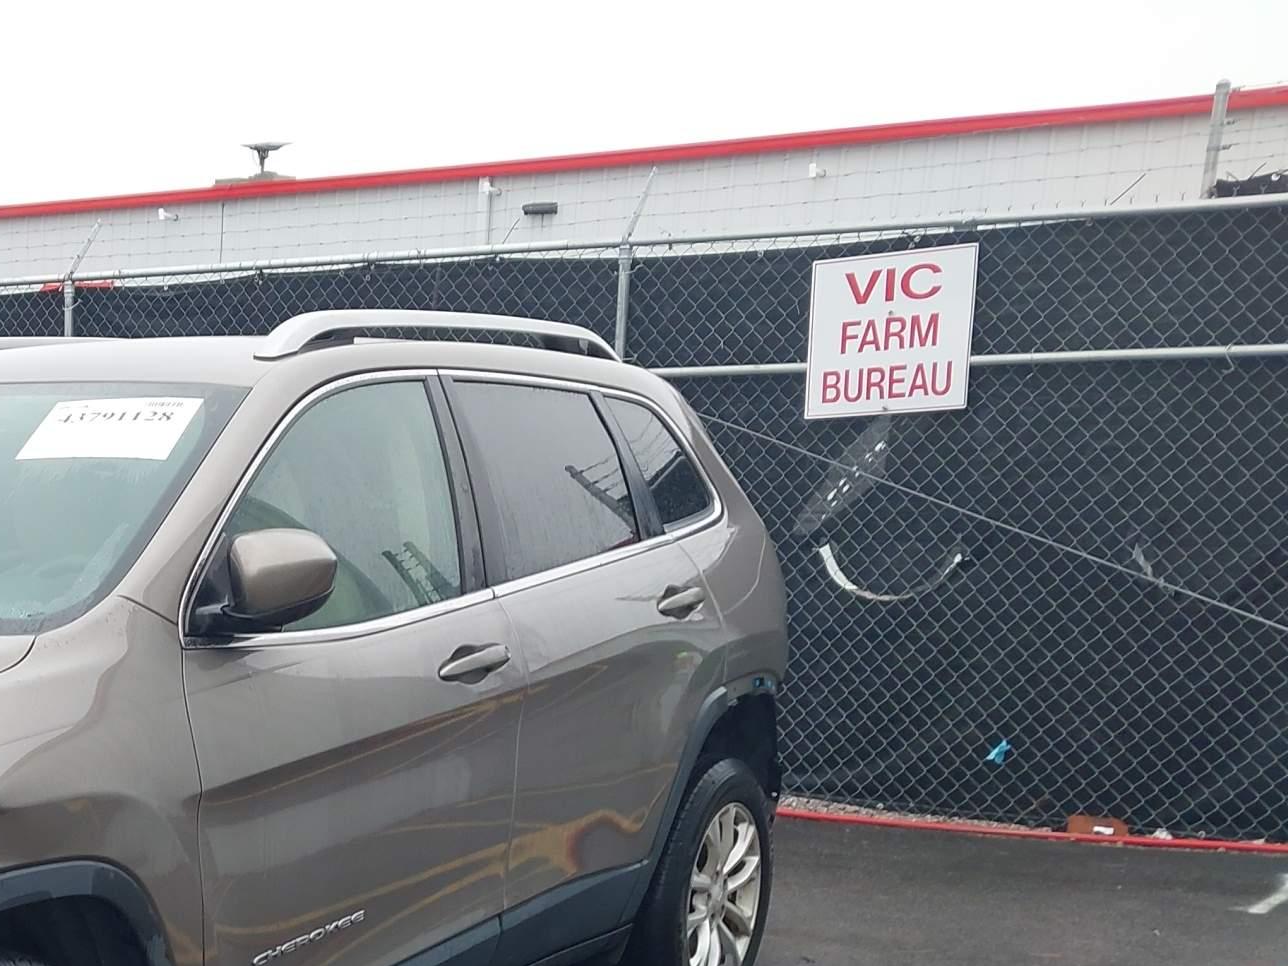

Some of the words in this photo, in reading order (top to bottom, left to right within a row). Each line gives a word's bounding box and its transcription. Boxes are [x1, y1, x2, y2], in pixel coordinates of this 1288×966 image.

[845, 263, 943, 305] VIC
[839, 313, 940, 354] FARM
[821, 361, 953, 404] BUREAU
[58, 410, 175, 424] 43791128
[252, 909, 365, 966] CHEROKEE
